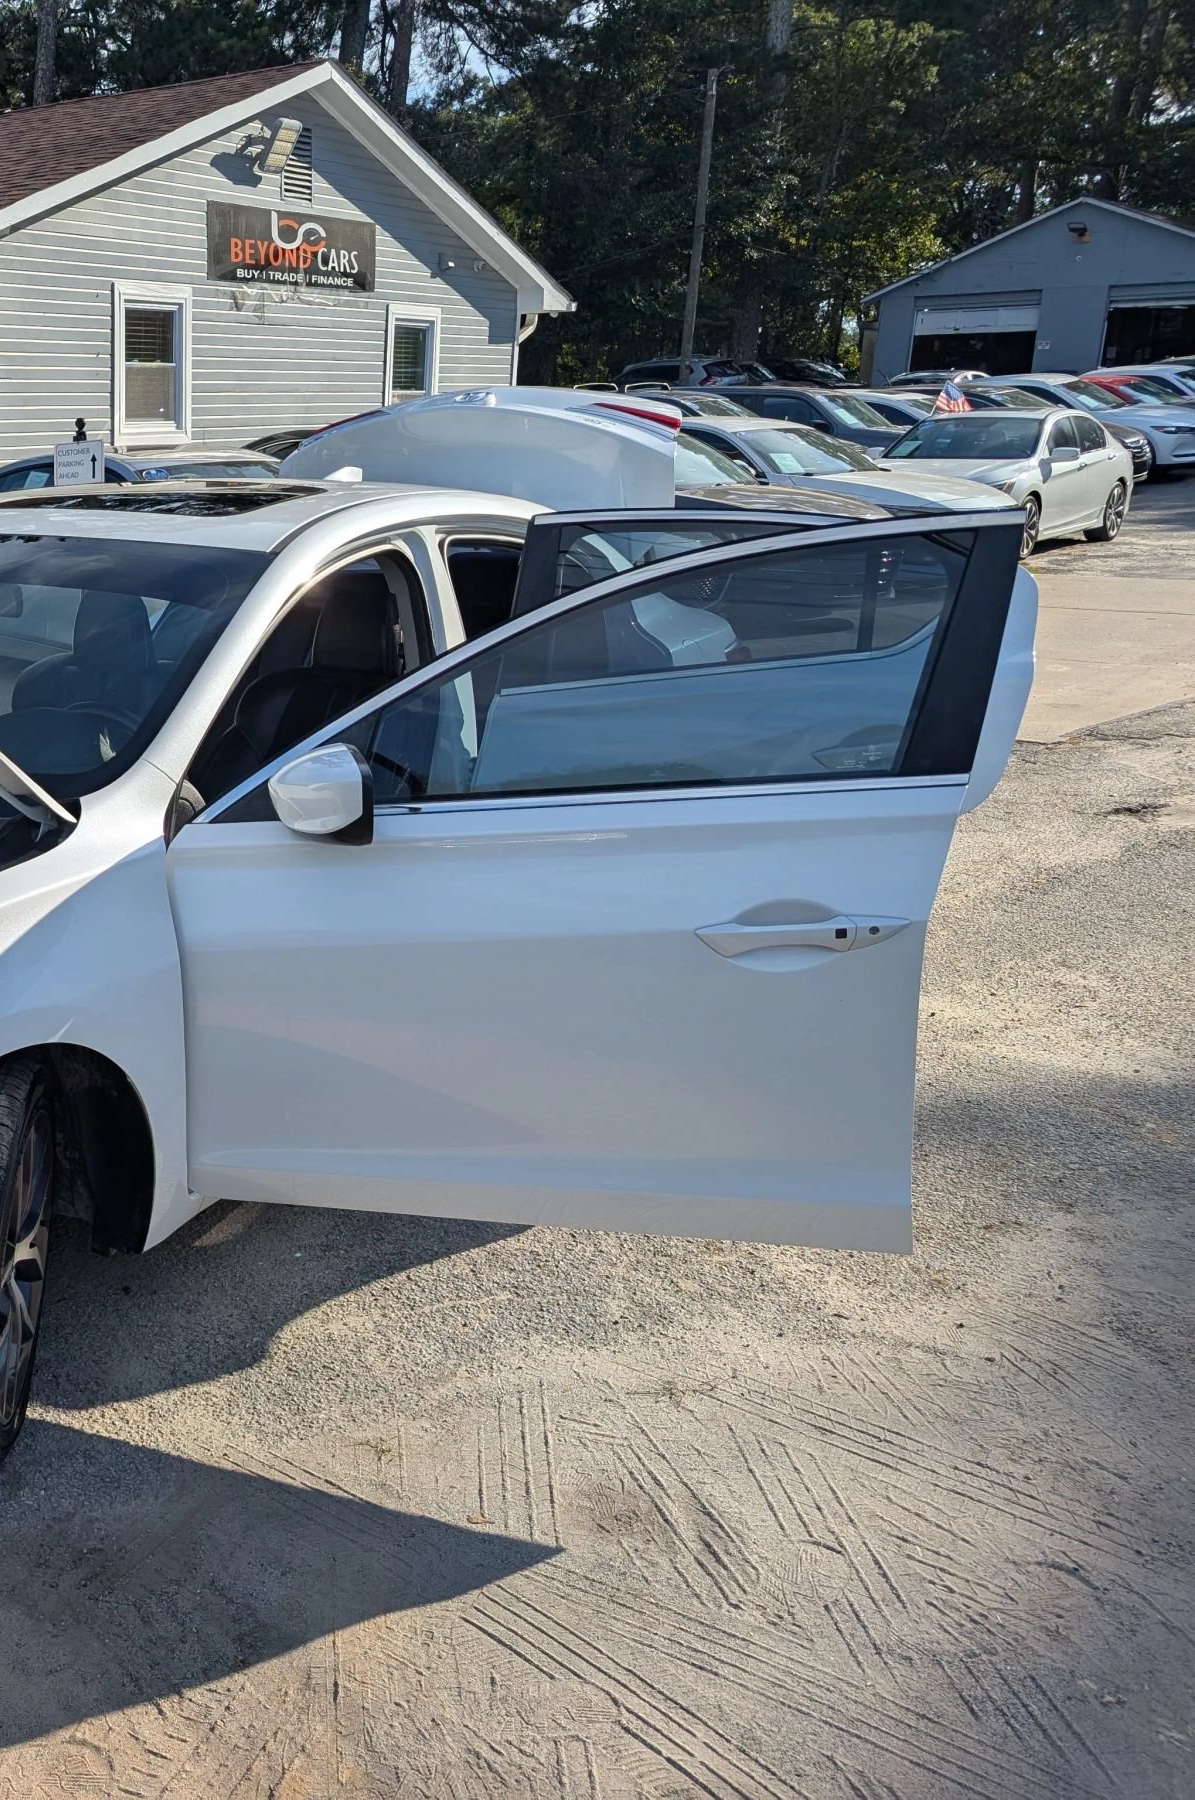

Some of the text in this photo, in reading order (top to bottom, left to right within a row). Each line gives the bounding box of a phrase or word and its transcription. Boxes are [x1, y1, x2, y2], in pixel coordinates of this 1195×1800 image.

[230, 237, 359, 274] BEYOND CARS
[236, 268, 259, 279] BUY
[269, 271, 304, 283] TRADE
[311, 276, 354, 287] FINANCE
[57, 448, 90, 457] CUSTOMER
[58, 460, 84, 468] PARKING
